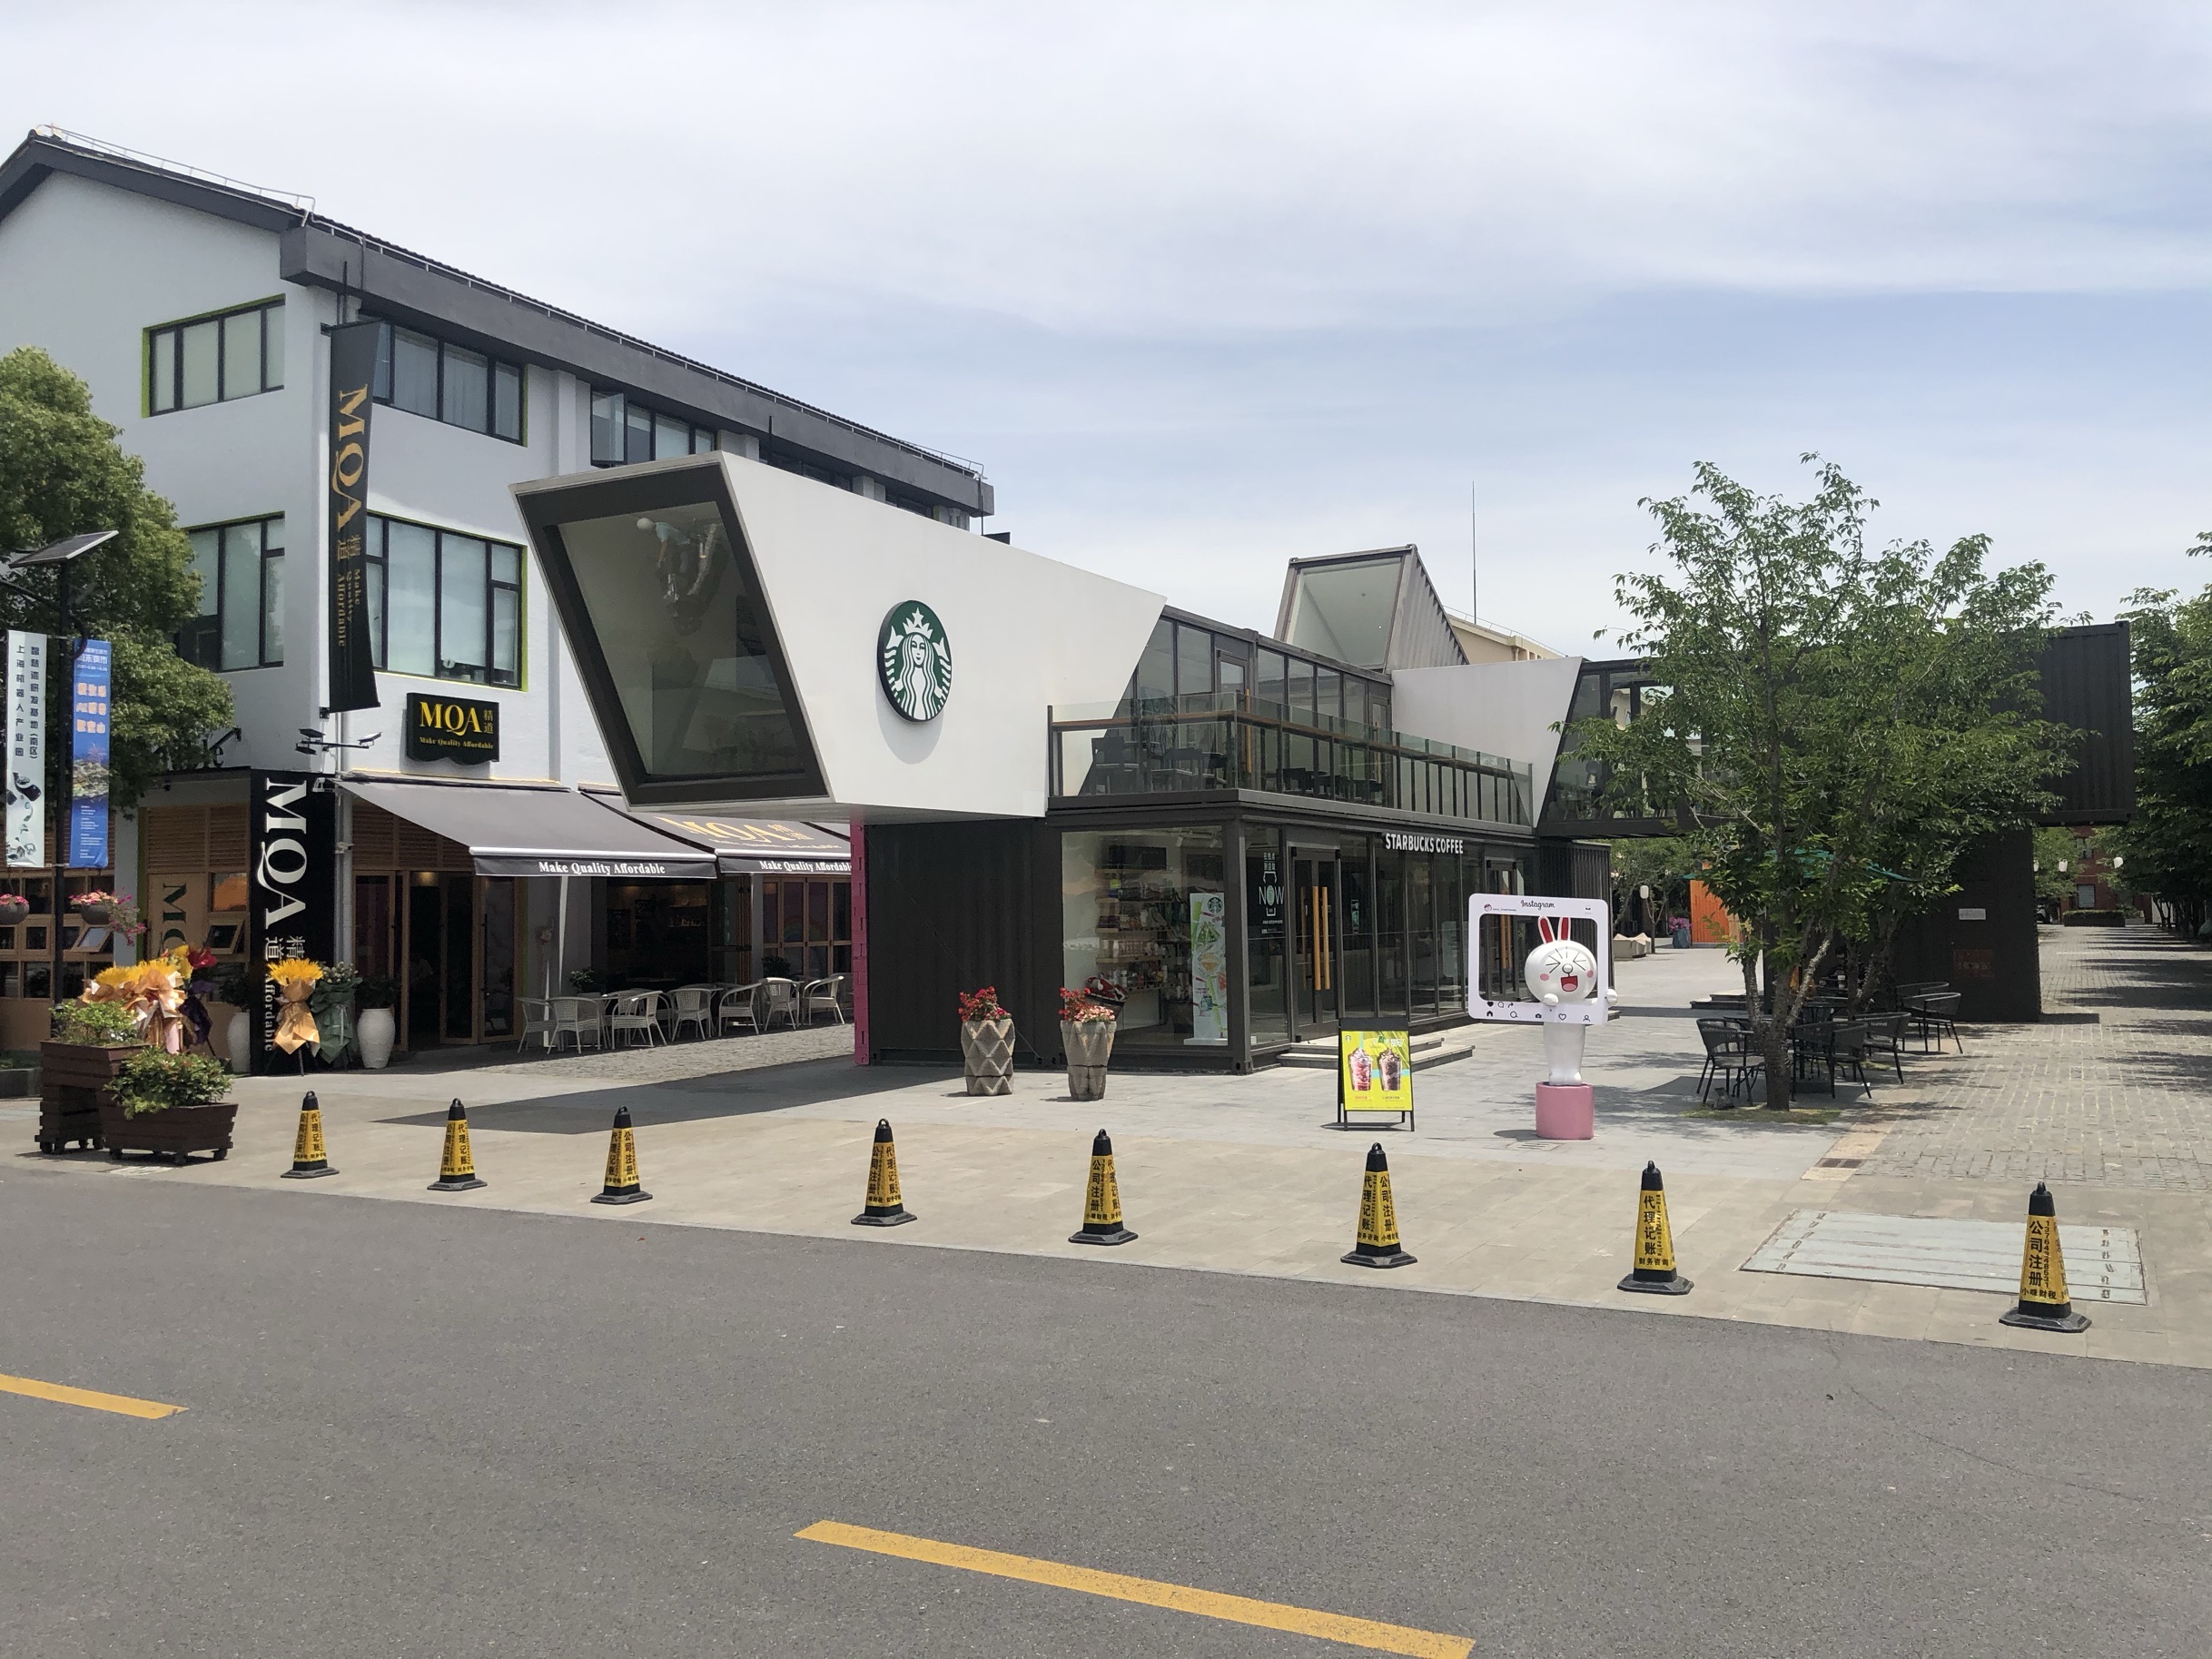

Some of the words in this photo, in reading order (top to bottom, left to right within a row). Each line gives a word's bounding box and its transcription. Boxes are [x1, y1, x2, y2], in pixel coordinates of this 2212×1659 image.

[332, 384, 368, 532] MQA
[337, 574, 346, 647] Affordable
[420, 701, 482, 736] MQA
[420, 736, 436, 745] Make
[438, 738, 460, 747] Quality
[462, 741, 494, 750] Affordable
[257, 777, 307, 930] MQA
[538, 862, 569, 873] Make
[571, 863, 611, 875] Quality
[614, 863, 666, 874] Affordable
[759, 861, 783, 870] Make
[783, 861, 813, 872] Quality
[1385, 833, 1435, 854] STARBUCKS
[1436, 837, 1464, 854] COFFEE
[1521, 899, 1555, 911] Instagram
[1091, 1159, 1101, 1211] 公司注册
[1361, 1175, 1372, 1231] 代理记账
[1379, 1175, 1392, 1231] 公司注册
[1644, 1195, 1656, 1255] 代理记账
[1638, 1257, 1669, 1266] 财务咨询
[2028, 1220, 2043, 1287] 公司注册
